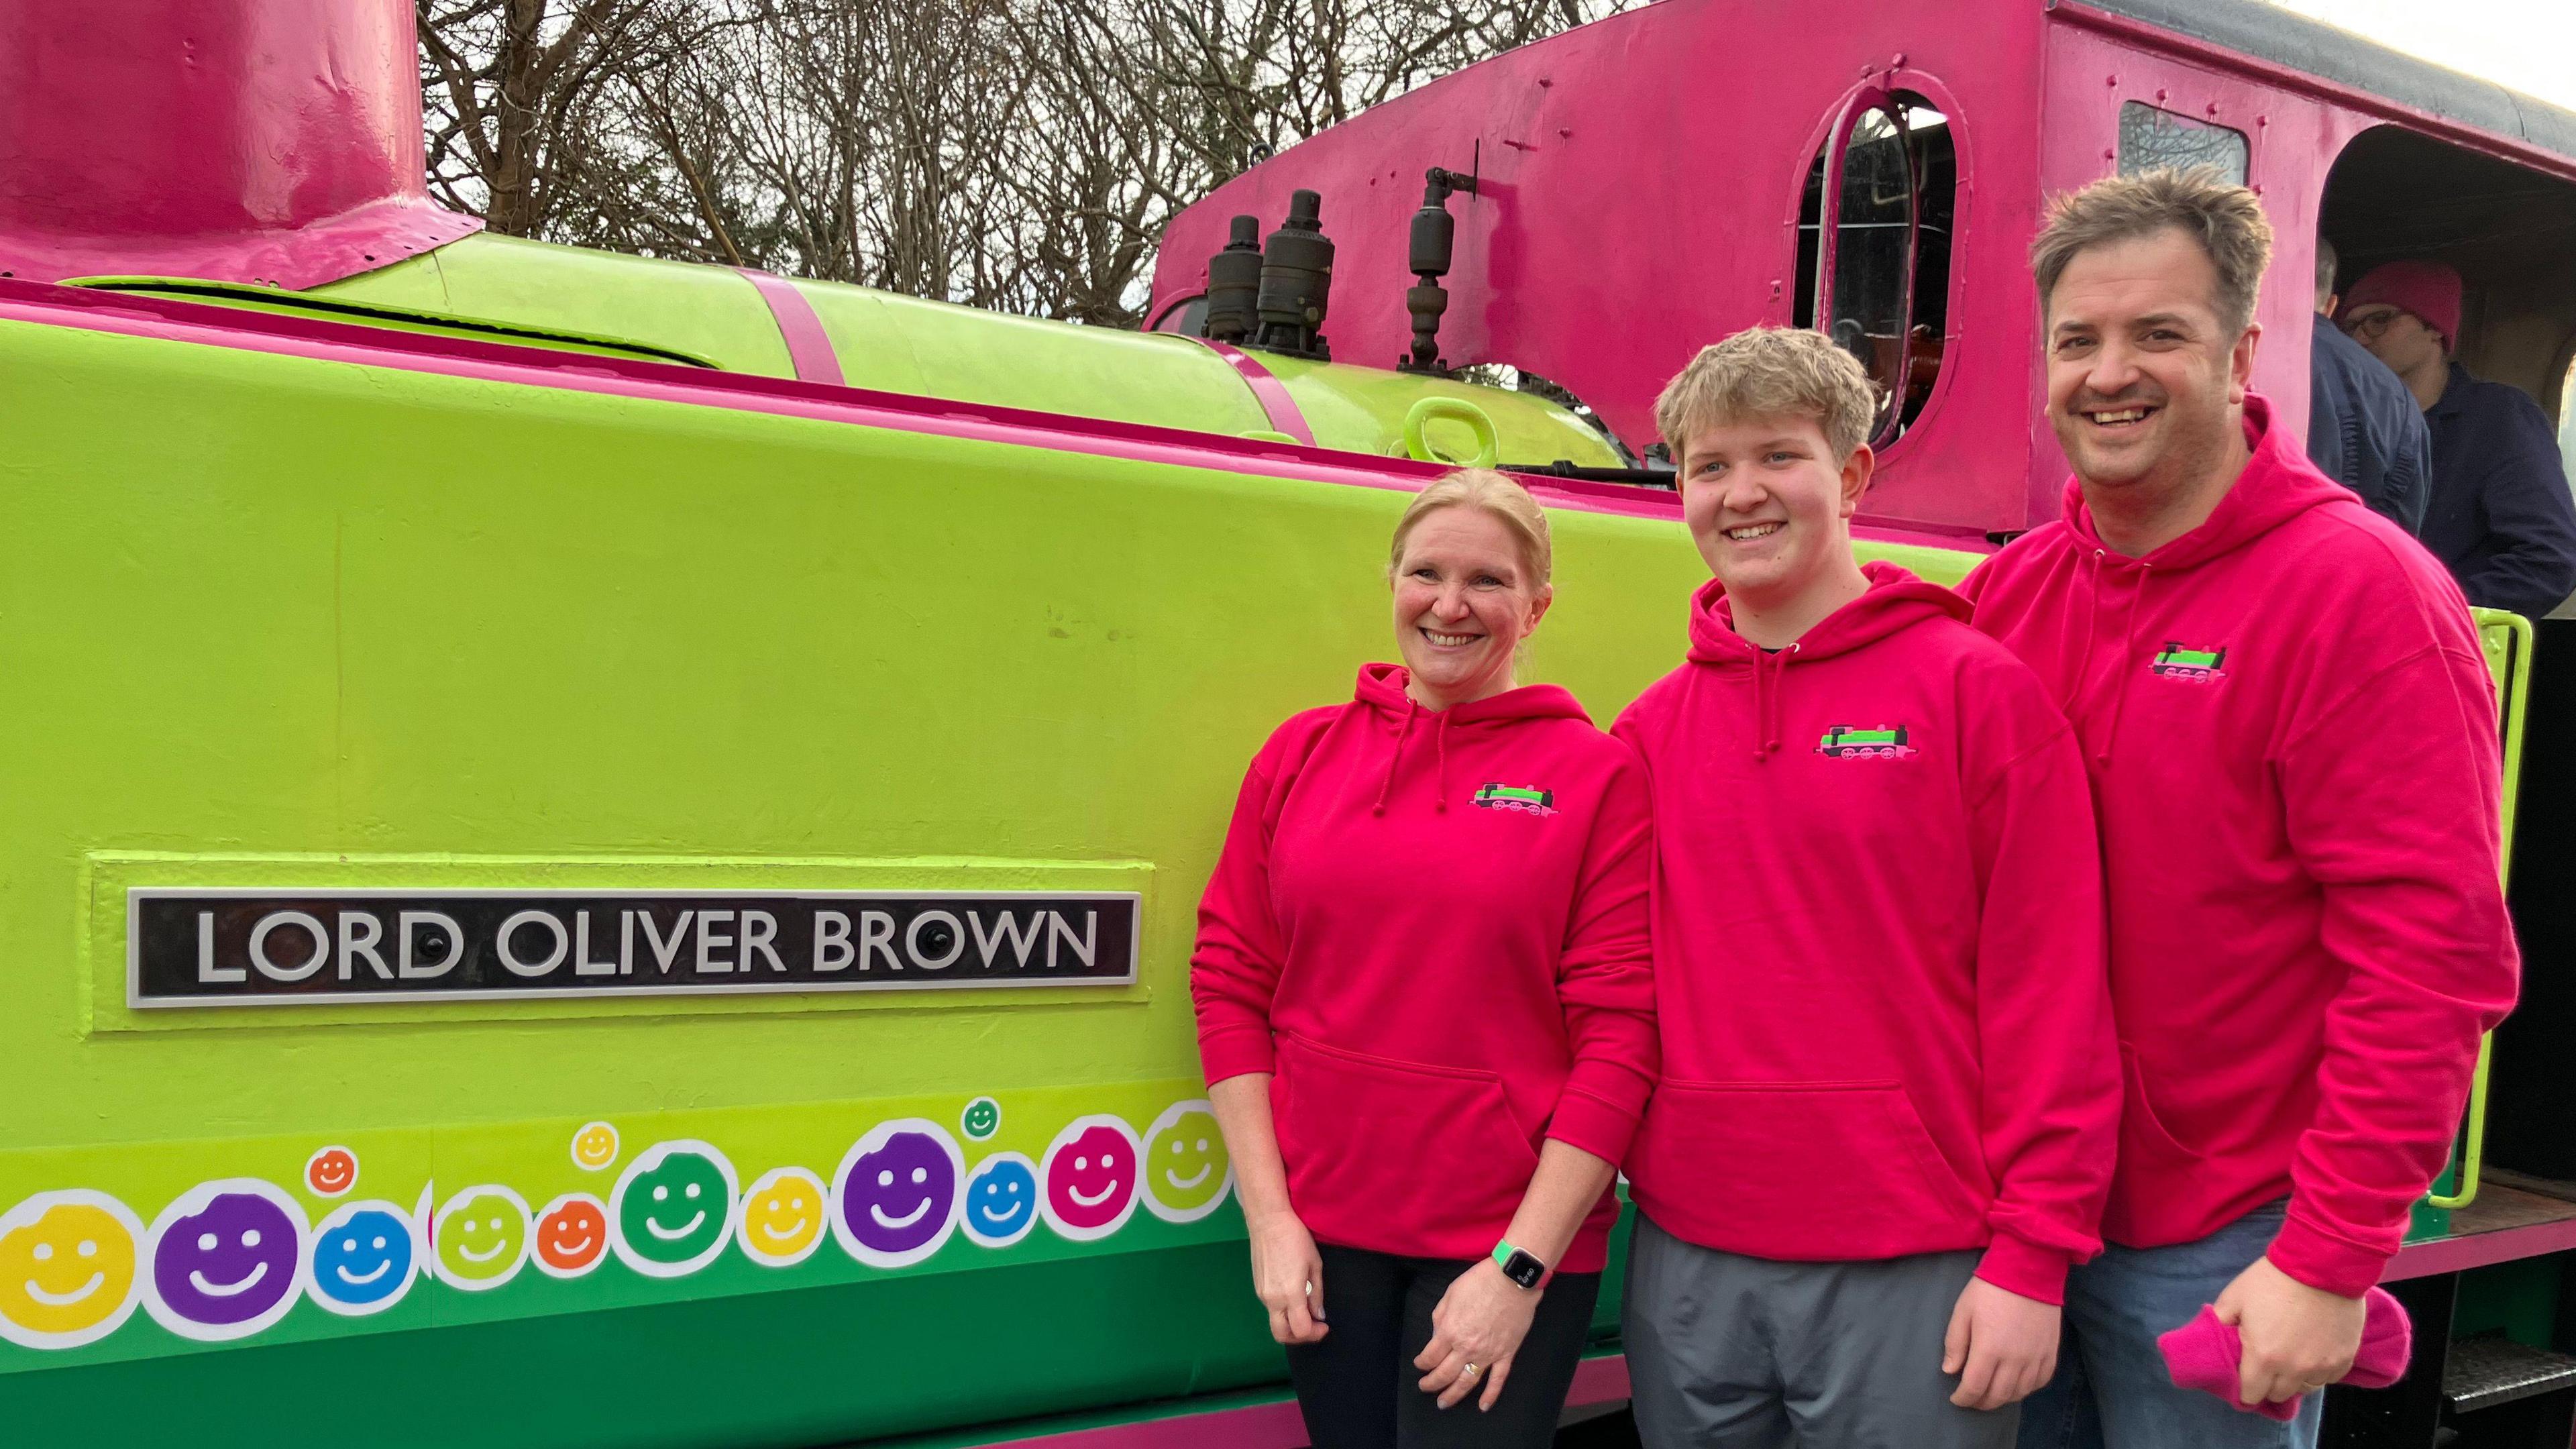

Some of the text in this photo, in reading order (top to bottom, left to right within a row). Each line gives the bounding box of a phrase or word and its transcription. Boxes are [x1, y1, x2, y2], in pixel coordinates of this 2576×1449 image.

[198, 910, 1097, 983] LORD OLIVER BROWN
